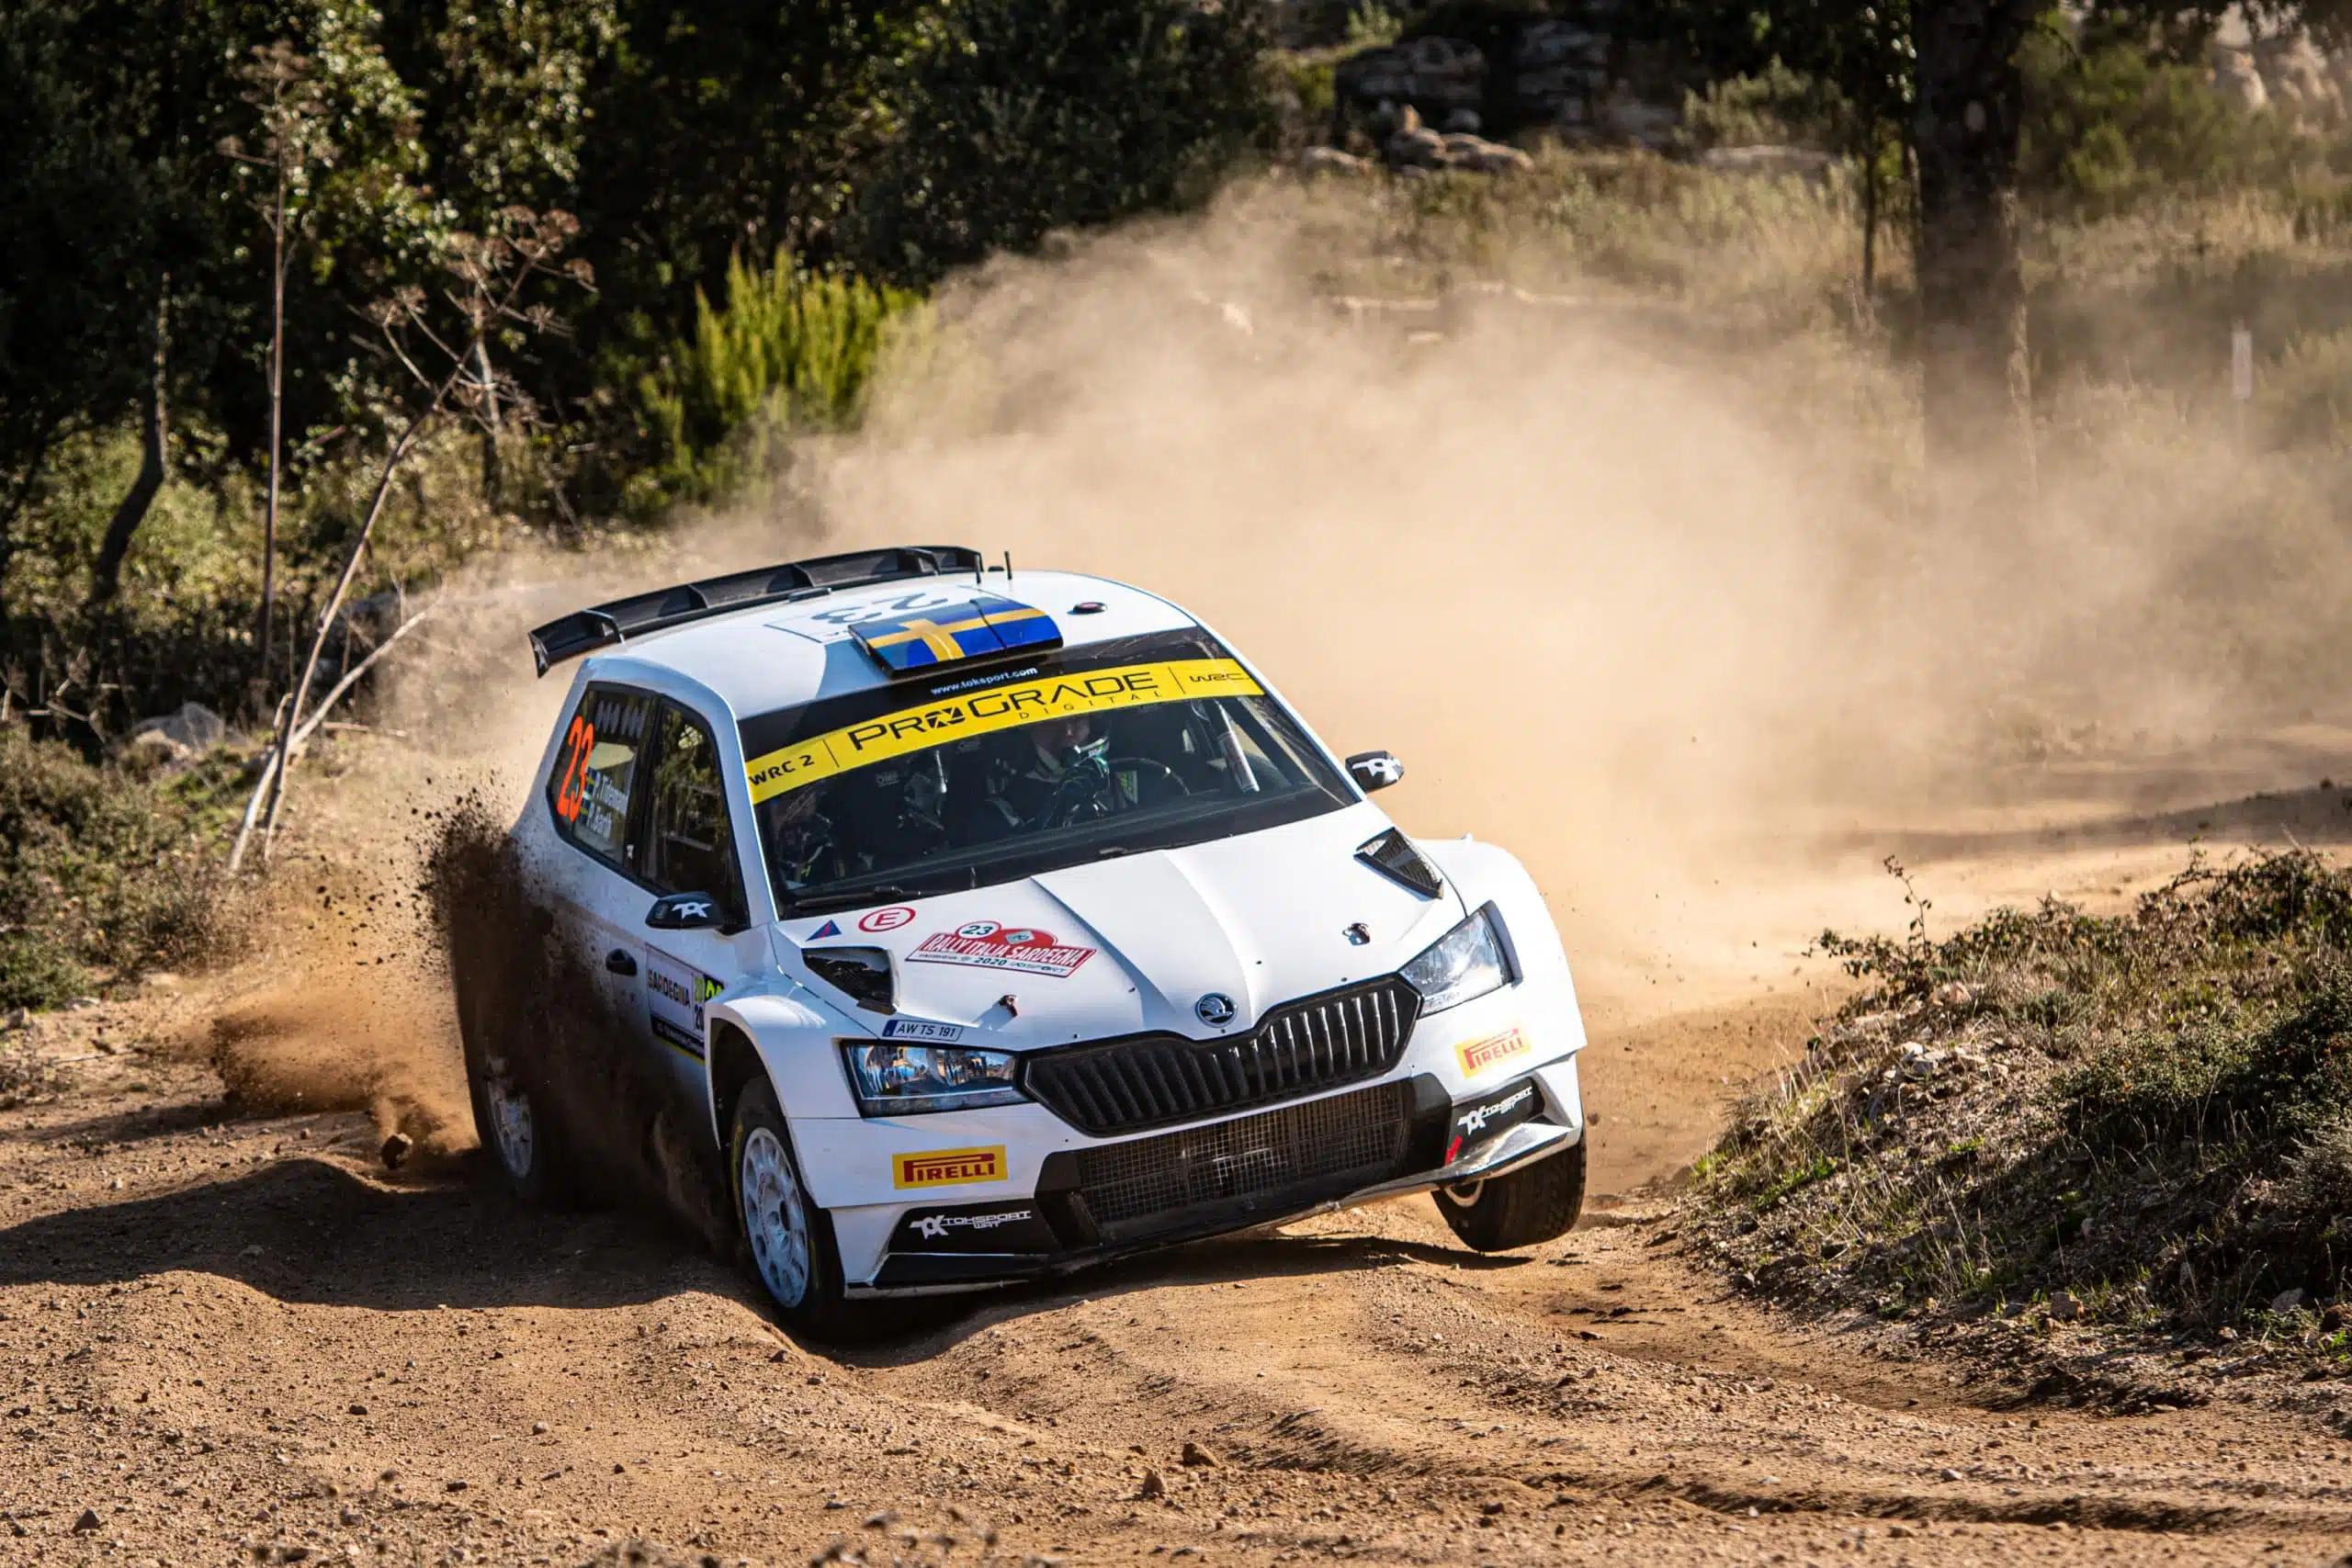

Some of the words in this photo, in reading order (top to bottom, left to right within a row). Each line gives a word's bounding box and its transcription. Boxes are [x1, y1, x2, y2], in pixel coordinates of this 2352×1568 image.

[1018, 693, 1162, 720] DIGITAL
[557, 715, 594, 823] 23
[748, 761, 796, 786] WRC
[799, 754, 816, 768] 2
[874, 911, 901, 927] E
[962, 925, 993, 936] 23
[923, 933, 971, 953] RALLY
[964, 940, 1011, 958] ITALIA
[1011, 945, 1088, 968] SARDEGNA
[973, 956, 1007, 965] 2020
[896, 1023, 919, 1034] AW
[920, 1024, 936, 1036] TS
[938, 1025, 956, 1038] 191
[1463, 1028, 1524, 1070] PIRELLI
[903, 1153, 995, 1183] PIRELLI
